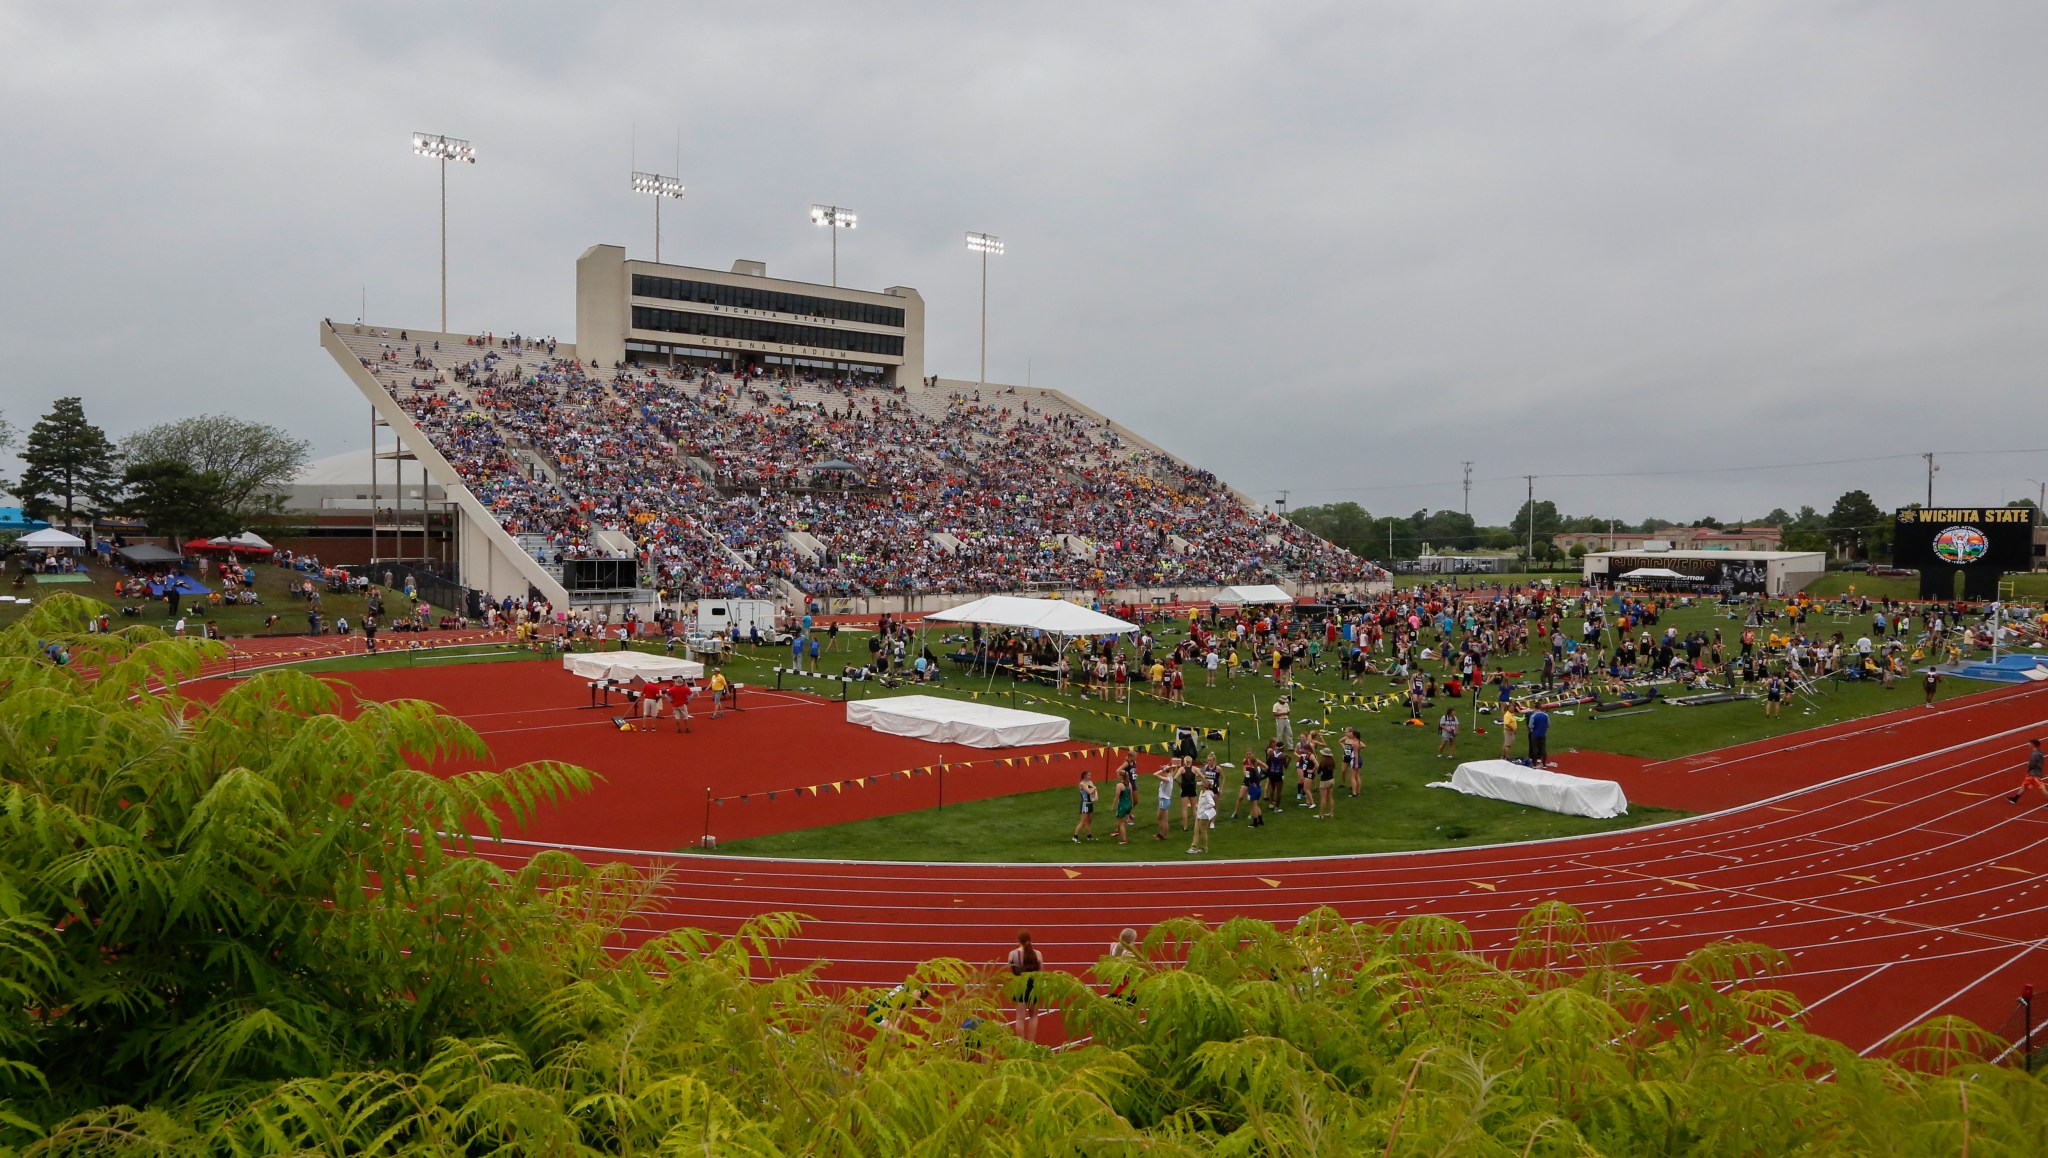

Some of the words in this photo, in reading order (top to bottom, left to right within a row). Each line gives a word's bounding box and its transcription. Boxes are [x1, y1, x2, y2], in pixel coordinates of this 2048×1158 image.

[714, 305, 776, 317] WICHITA
[794, 314, 835, 324] STATE
[702, 337, 766, 349] CESSNA
[779, 345, 846, 357] STADIUM
[1920, 510, 1979, 522] WICHITA
[1985, 510, 2029, 522] STATE
